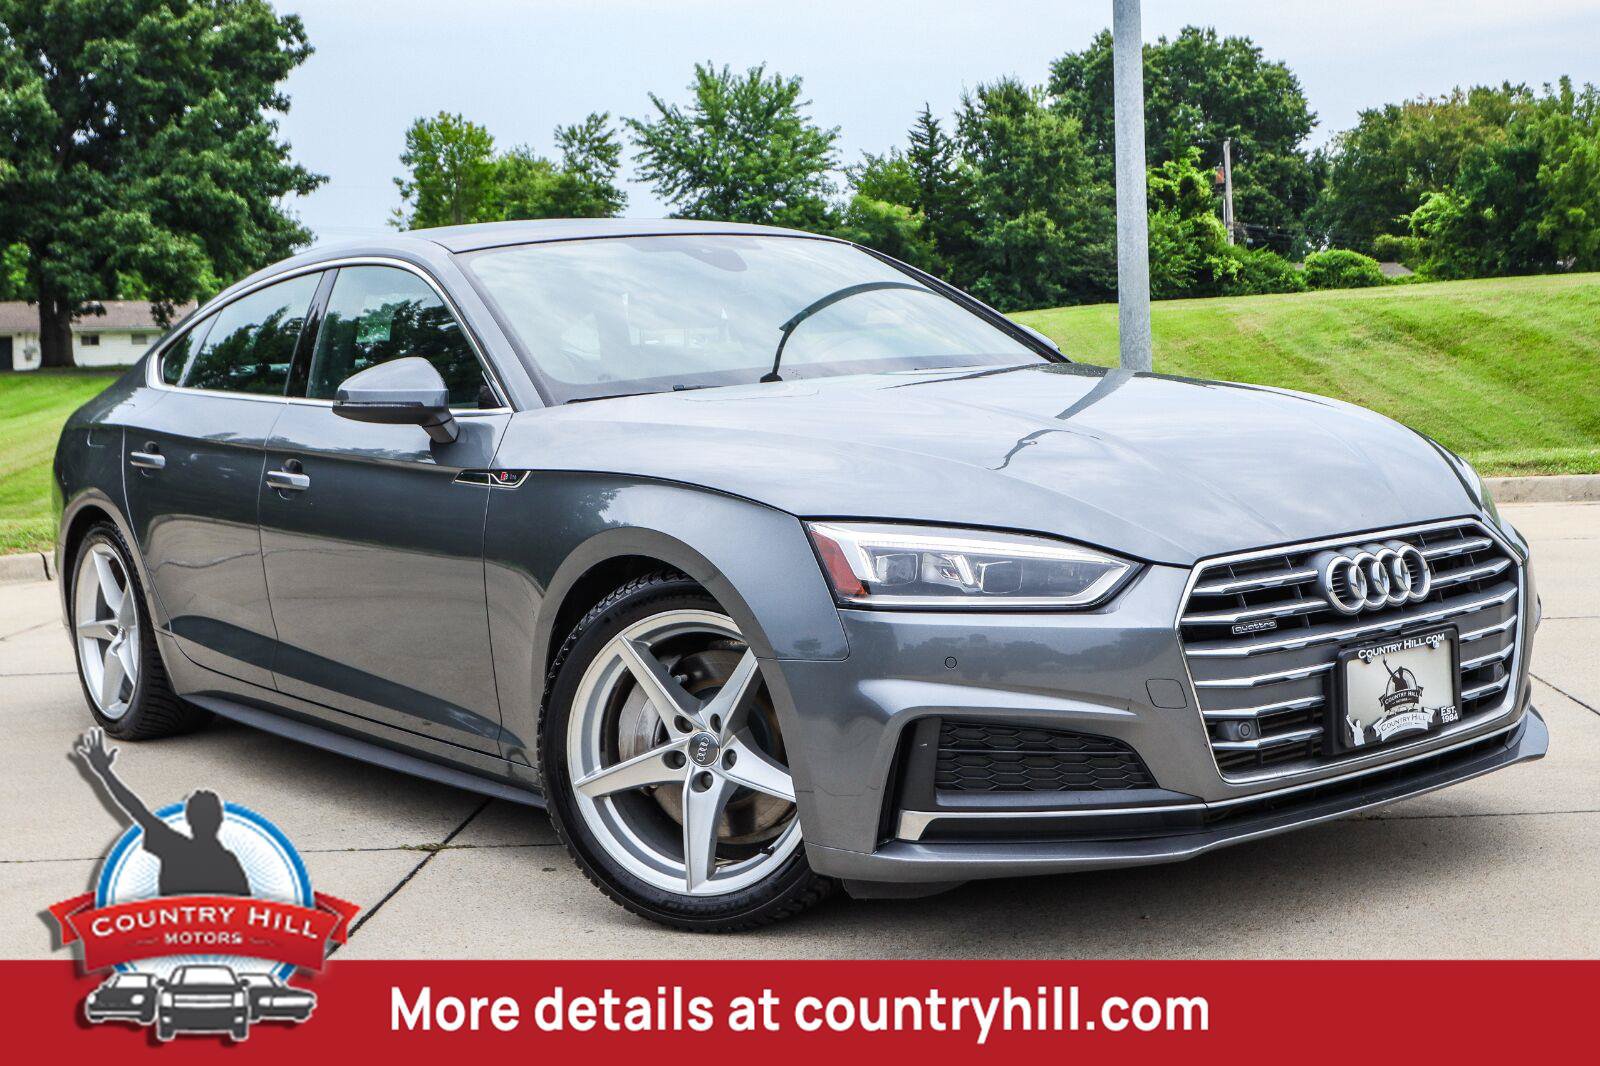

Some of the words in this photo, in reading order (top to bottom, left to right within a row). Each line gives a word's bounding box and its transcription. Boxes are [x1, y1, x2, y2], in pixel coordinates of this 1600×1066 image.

[1234, 621, 1275, 632] quattro
[1358, 642, 1403, 659] COUNTRY
[1381, 716, 1411, 731] COUNTRY
[1411, 713, 1426, 721] HILL
[1442, 713, 1459, 723] 1984
